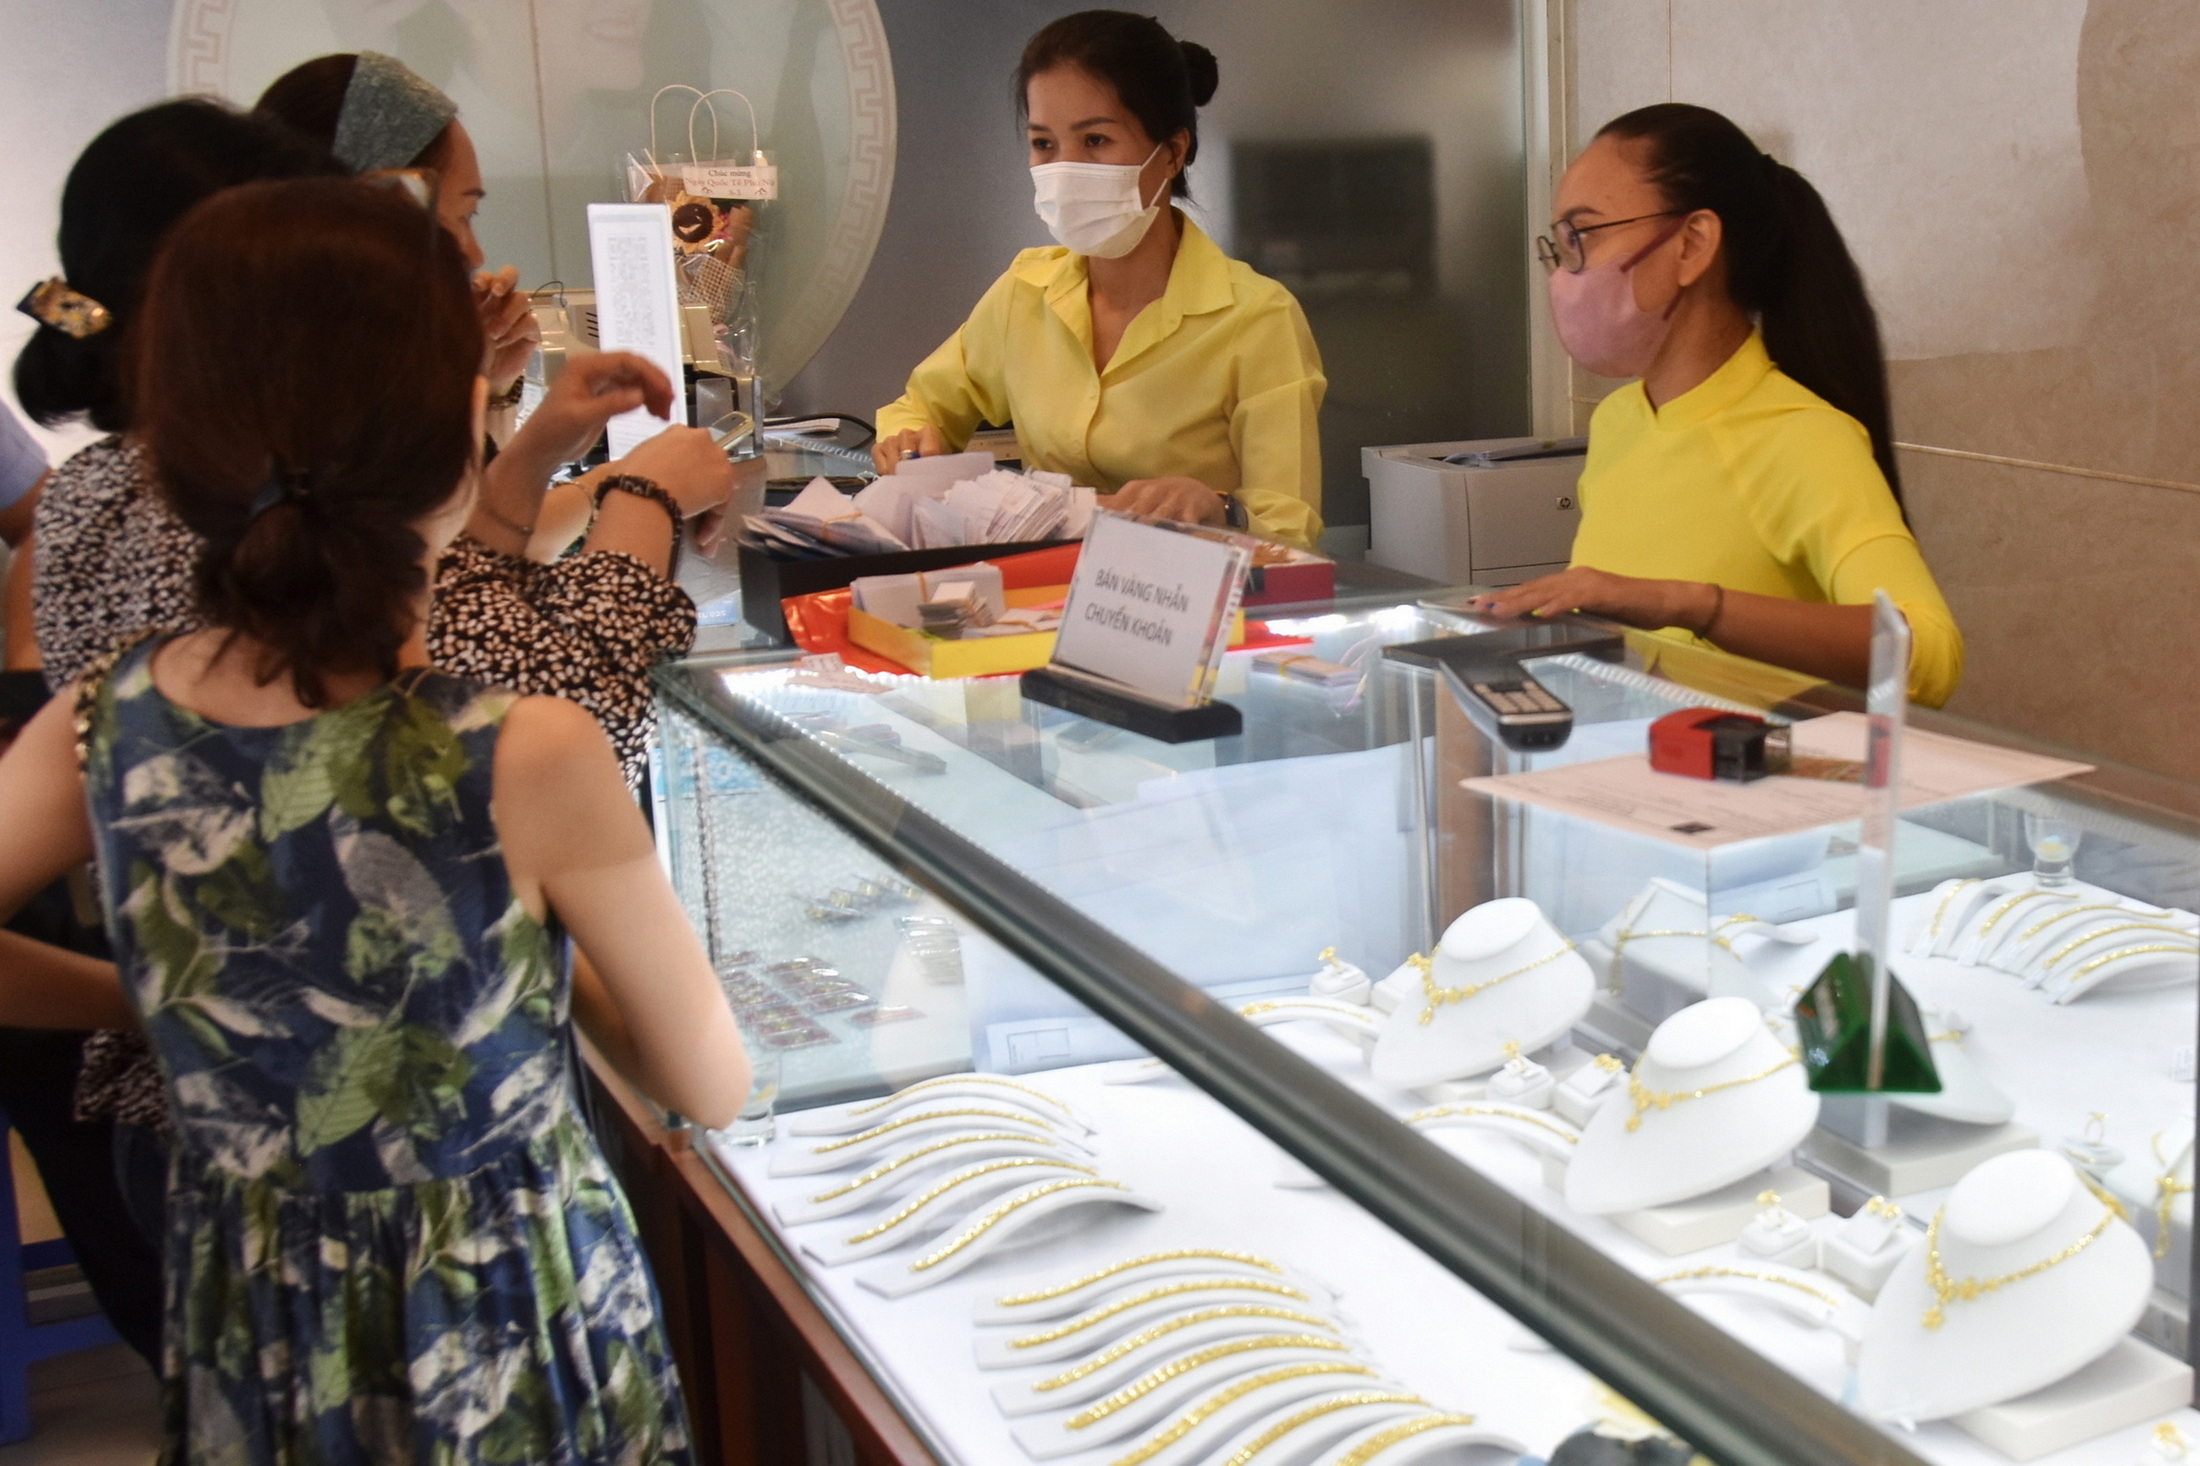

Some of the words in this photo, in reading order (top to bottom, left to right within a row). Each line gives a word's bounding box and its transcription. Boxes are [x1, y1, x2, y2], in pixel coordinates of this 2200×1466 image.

[1094, 567, 1119, 591] BÁN
[1121, 573, 1154, 602] VÀNG
[1154, 584, 1189, 612] NHẪN
